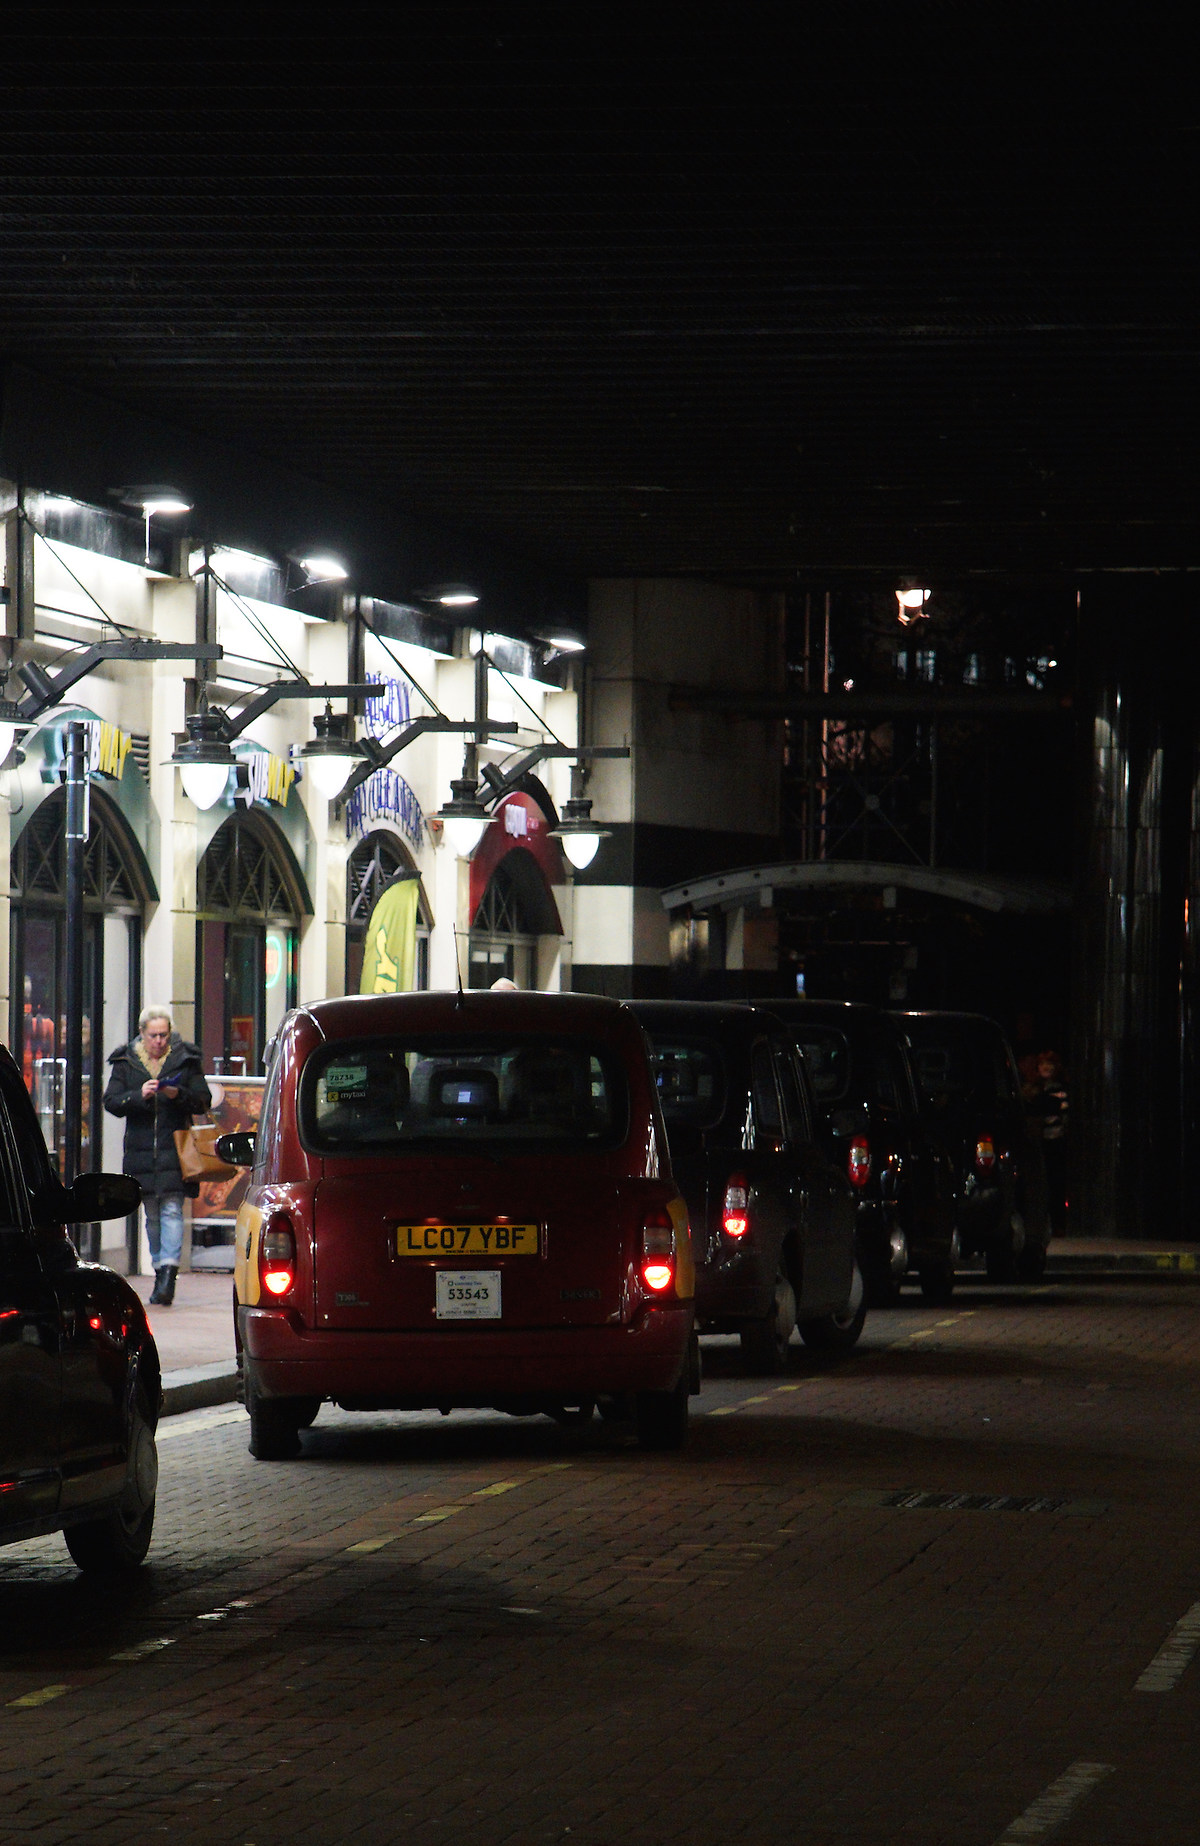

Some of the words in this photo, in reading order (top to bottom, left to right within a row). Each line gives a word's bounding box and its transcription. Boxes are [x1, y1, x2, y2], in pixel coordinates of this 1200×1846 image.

[234, 751, 295, 809] SUBWAY
[407, 1227, 471, 1250] LC07
[479, 1227, 526, 1249] YBF
[448, 1288, 489, 1300] 53543
